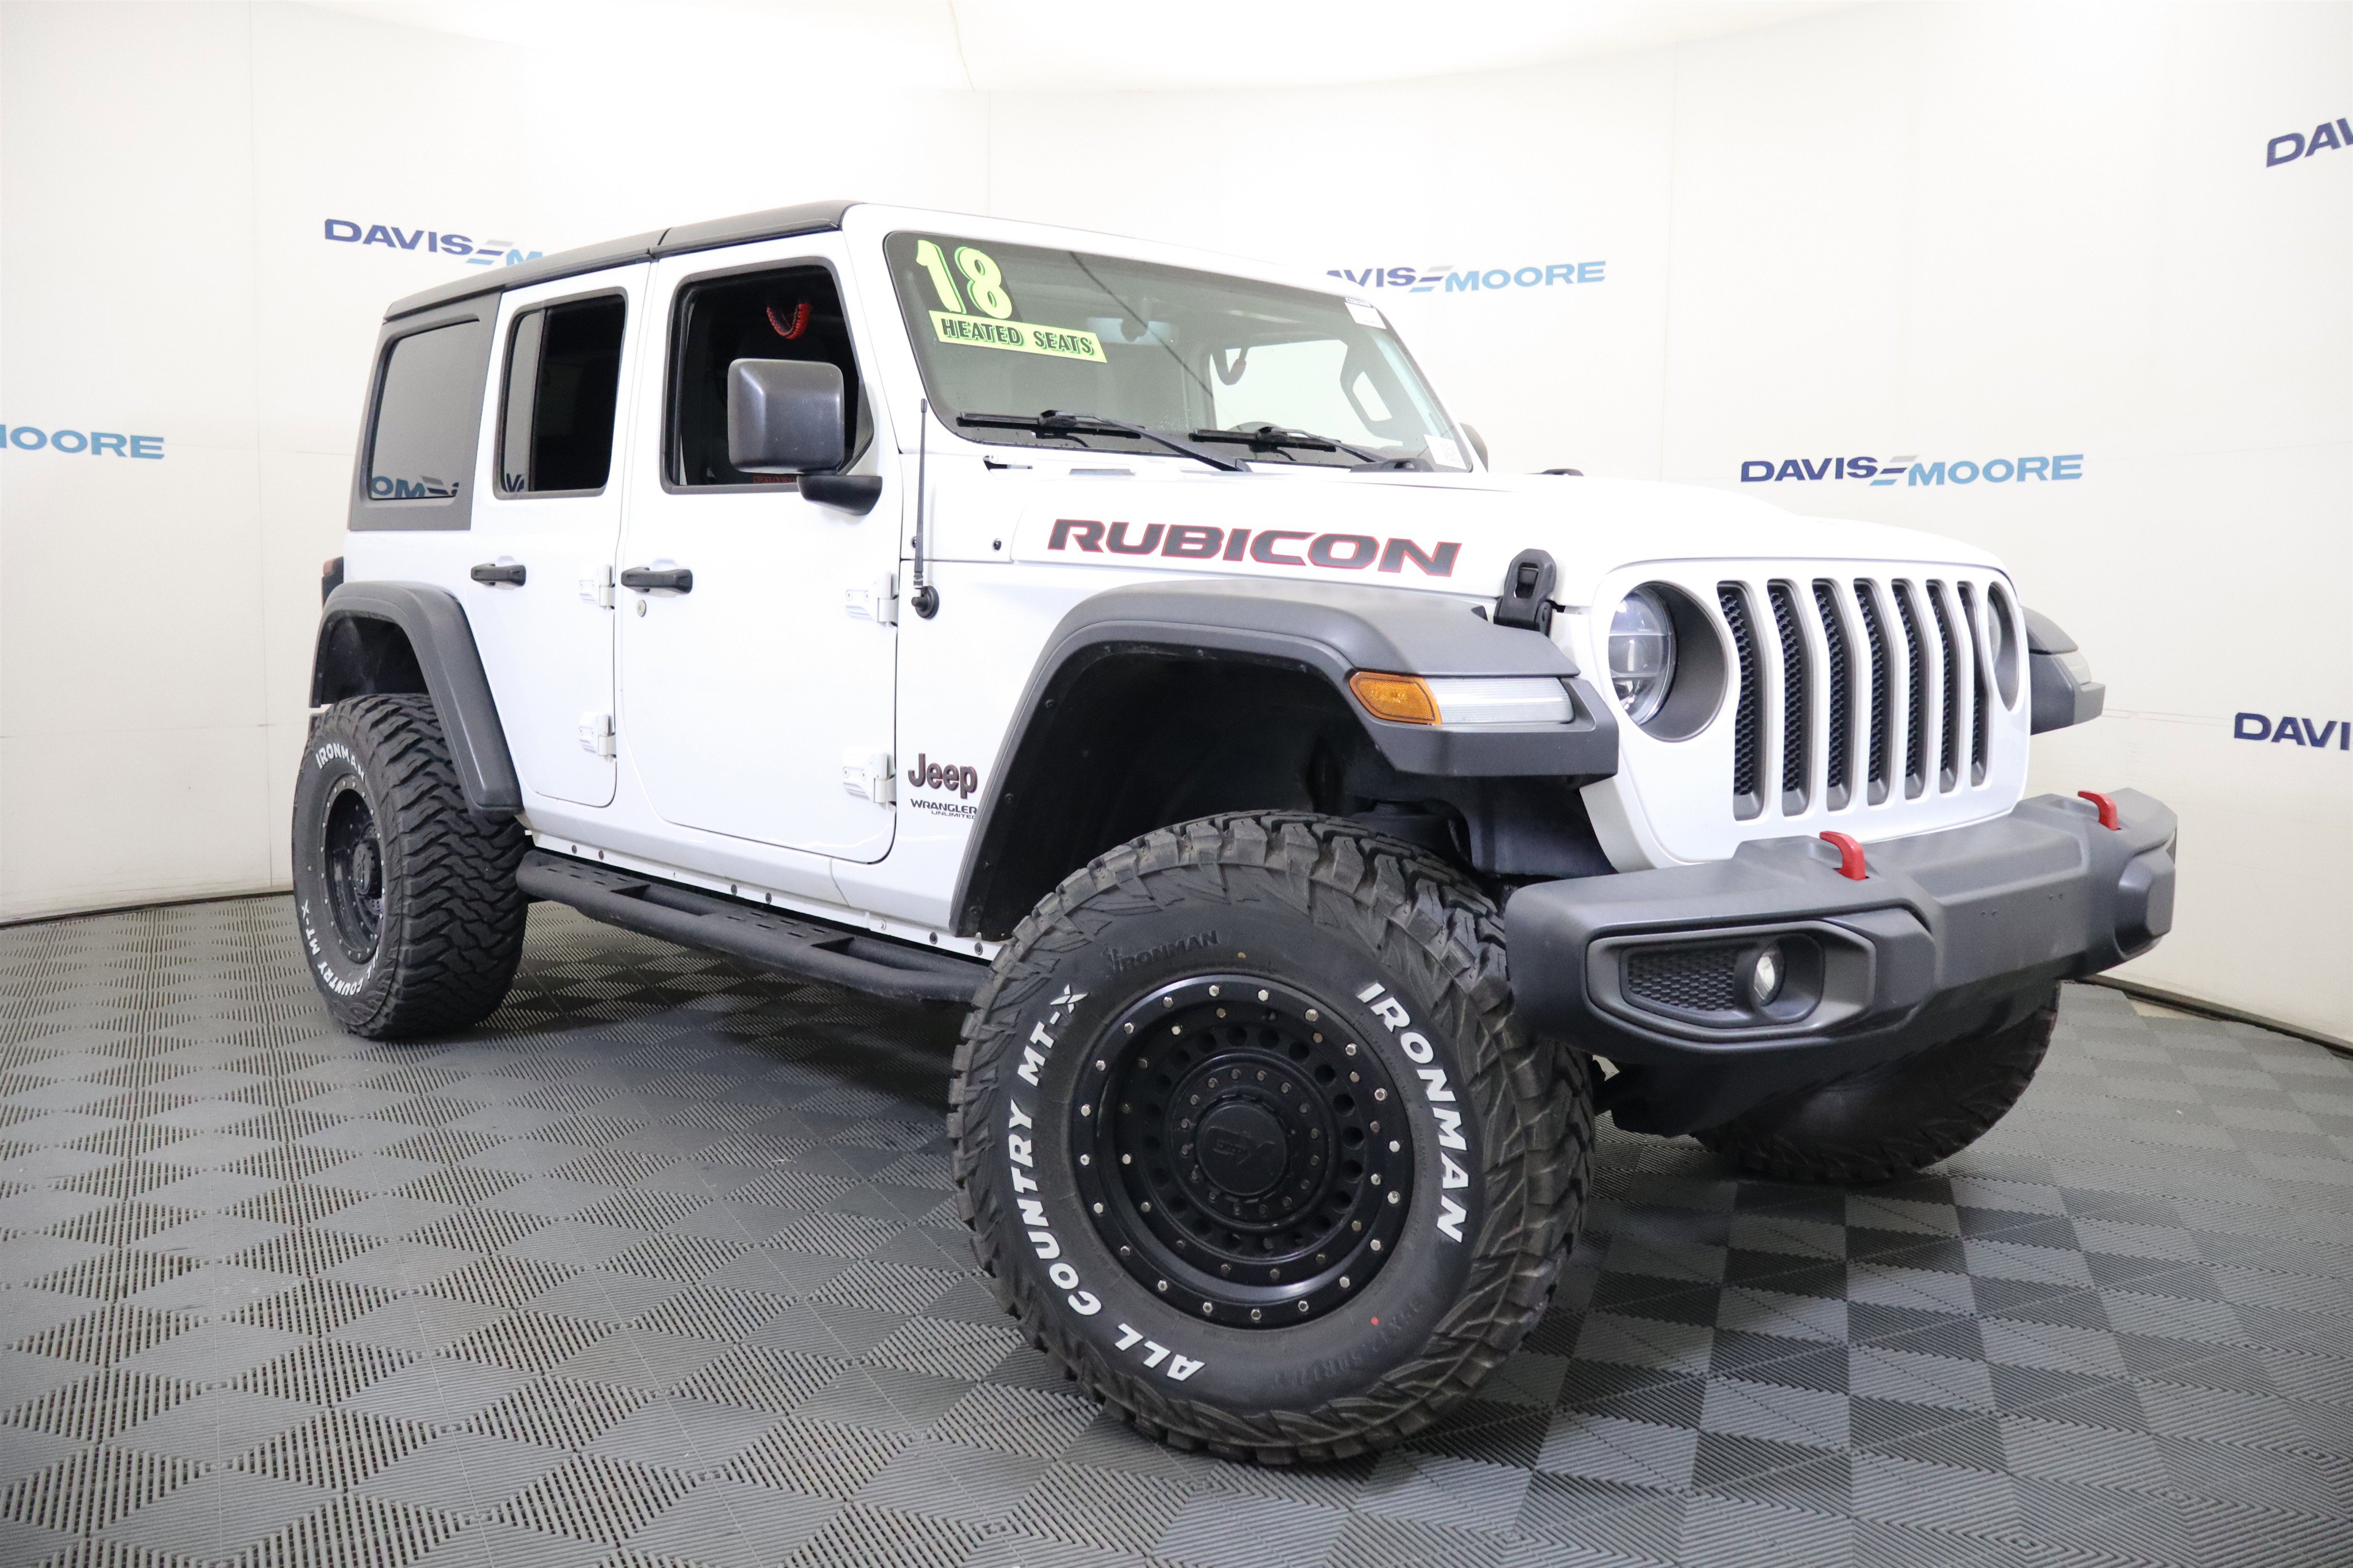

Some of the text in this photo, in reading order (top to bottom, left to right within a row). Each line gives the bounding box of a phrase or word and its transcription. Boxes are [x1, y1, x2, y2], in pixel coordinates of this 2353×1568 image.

[325, 218, 474, 255] DAVIS
[916, 240, 1013, 319] 18
[1445, 261, 1606, 292] MOORE
[940, 317, 1094, 356] HEATED SEATS
[0, 424, 165, 459] OORE
[1741, 454, 2084, 486] DAVIS MOORE
[1047, 518, 1463, 577] RUBICON
[316, 742, 365, 782] IRONMAN
[908, 752, 978, 800] Jeep
[910, 798, 978, 815] WRANGLER
[300, 898, 321, 956] MT-X
[1109, 929, 1220, 972] IRONMAN
[317, 961, 364, 996] COUNTRY
[1356, 983, 1469, 1243] IRONMAN
[1008, 984, 1205, 1381] ALL COUNTRY MT-X
